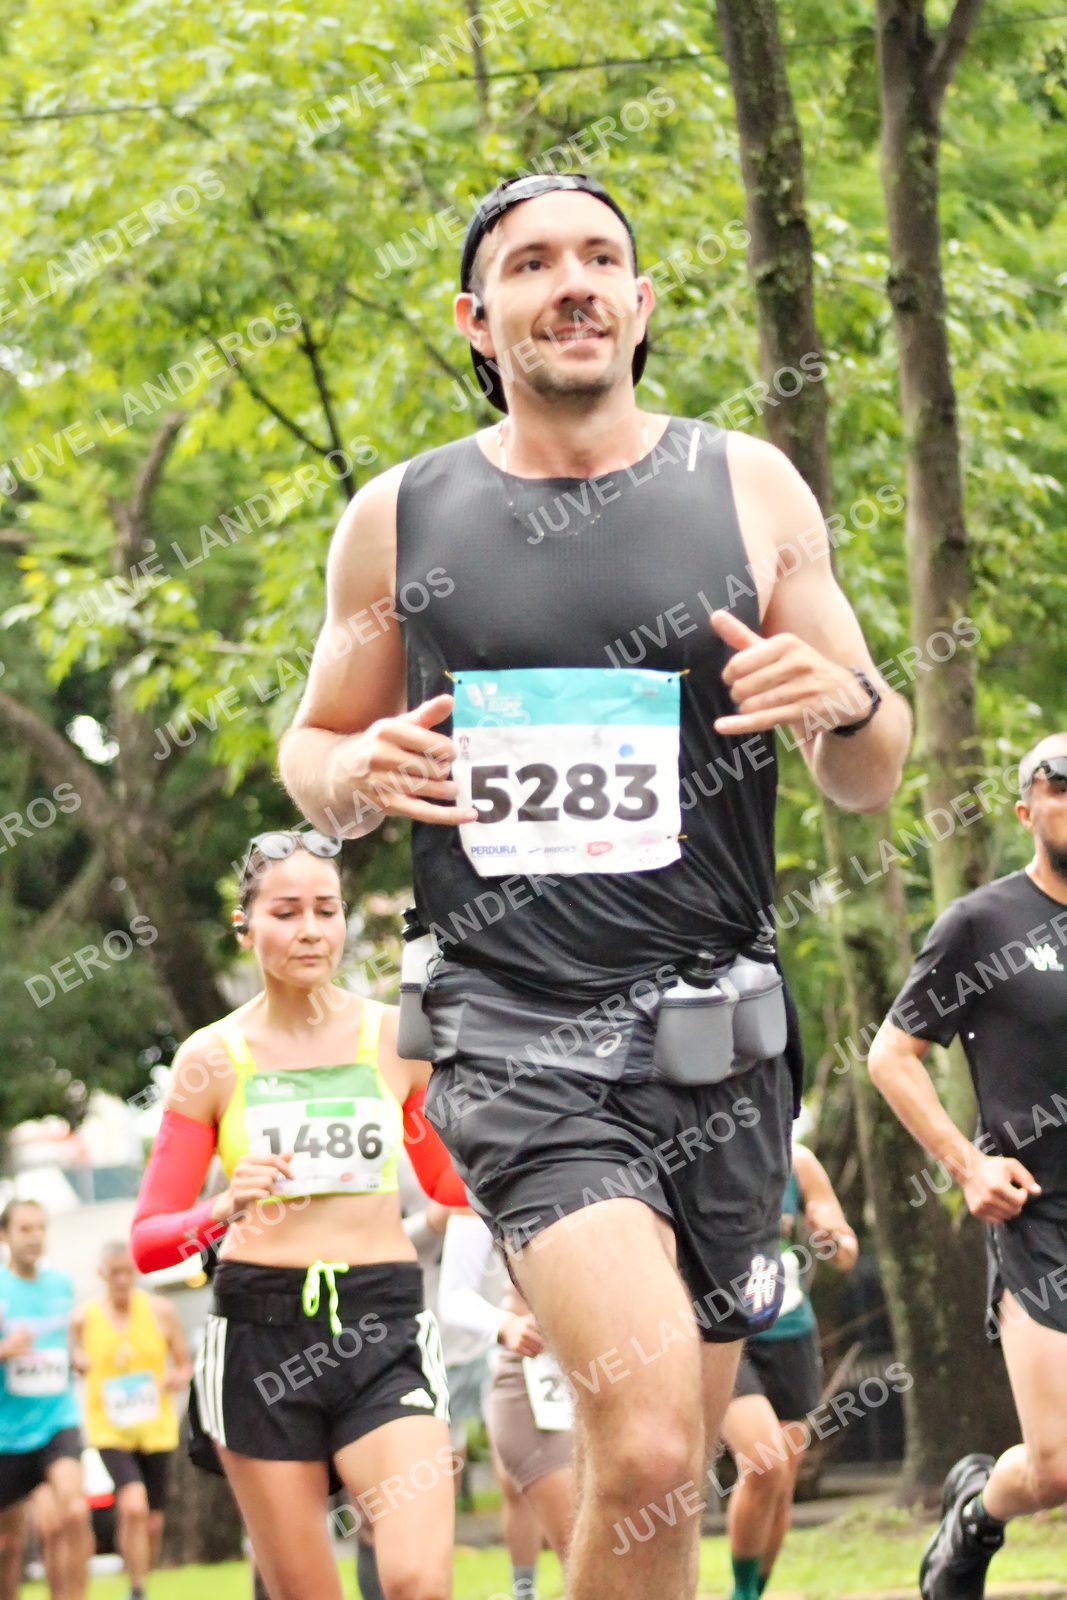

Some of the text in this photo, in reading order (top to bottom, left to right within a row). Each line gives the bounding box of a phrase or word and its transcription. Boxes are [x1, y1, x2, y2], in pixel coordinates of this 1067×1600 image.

[470, 763, 659, 824] 5283
[471, 845, 518, 856] PERDURA
[262, 1122, 383, 1160] 1486
